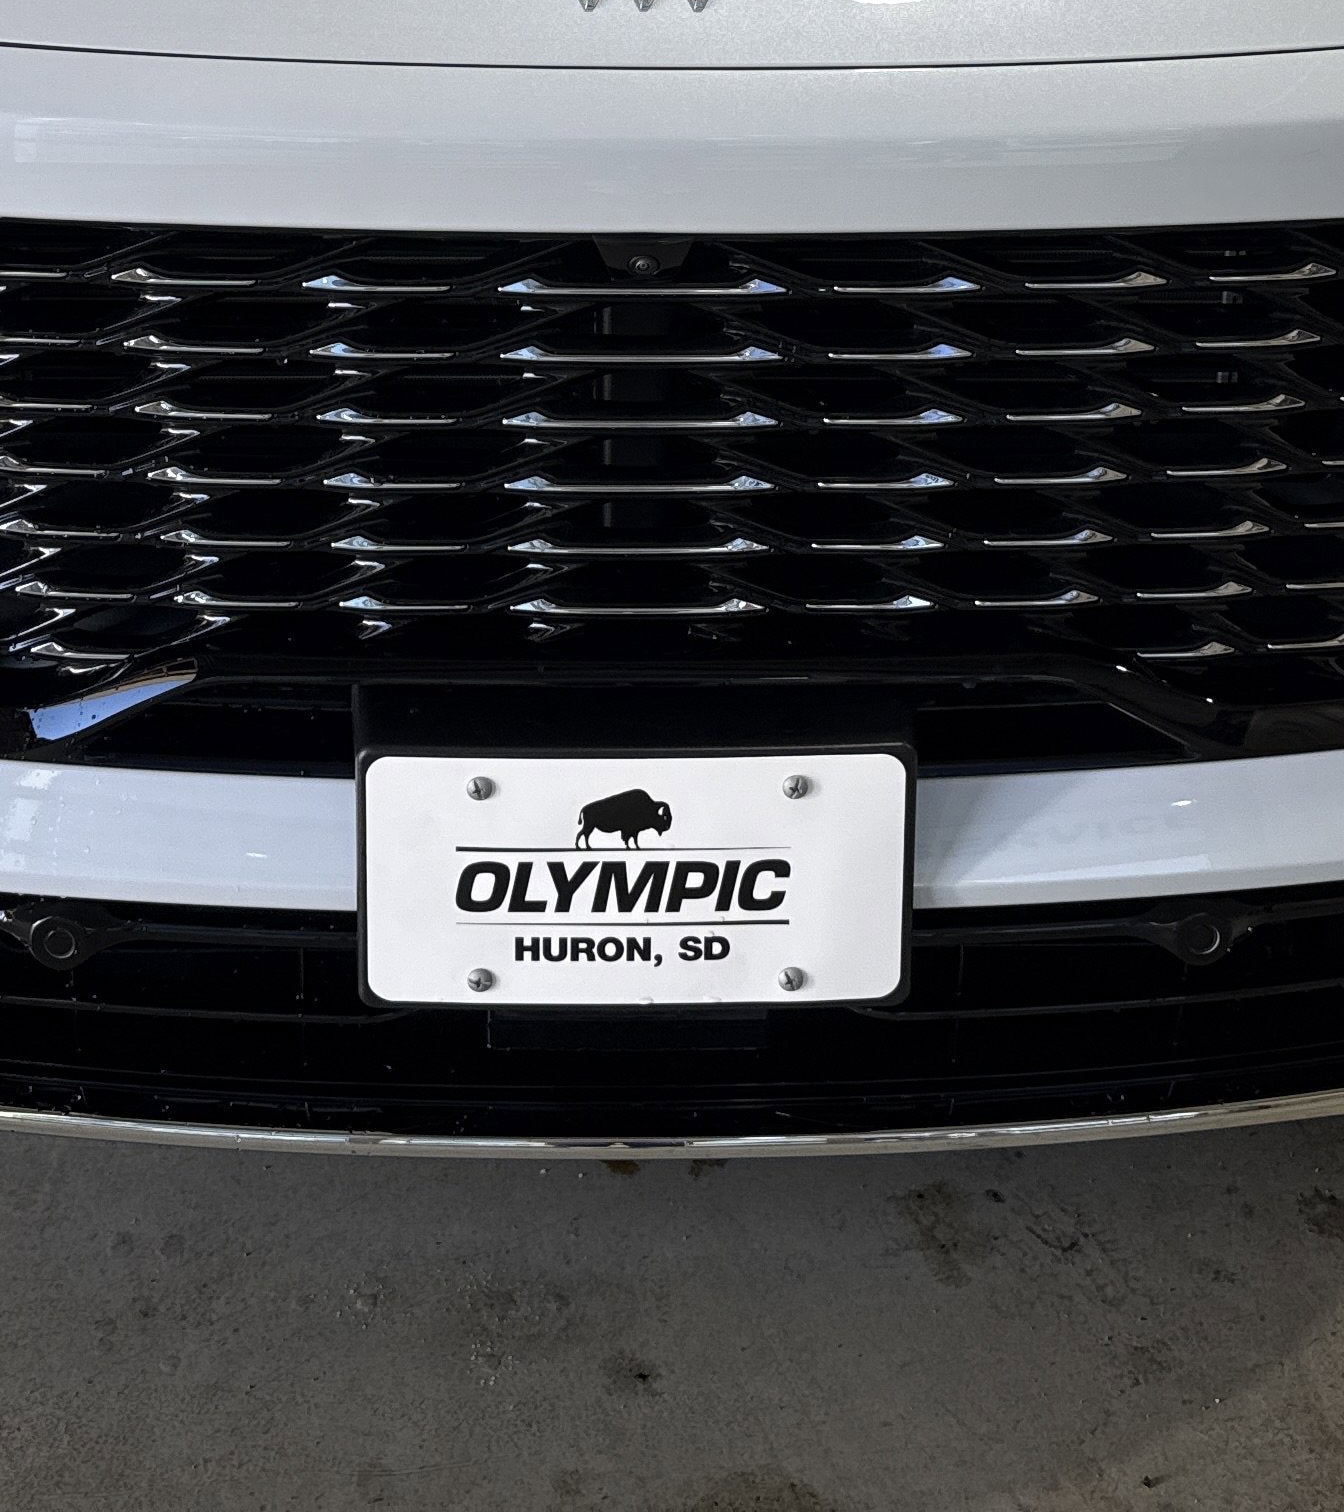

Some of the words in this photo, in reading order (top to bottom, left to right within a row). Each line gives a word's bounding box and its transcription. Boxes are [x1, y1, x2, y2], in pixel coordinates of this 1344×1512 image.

[455, 858, 791, 913] OLYMPIC
[514, 936, 663, 967] HURON,
[678, 935, 731, 961] SD
